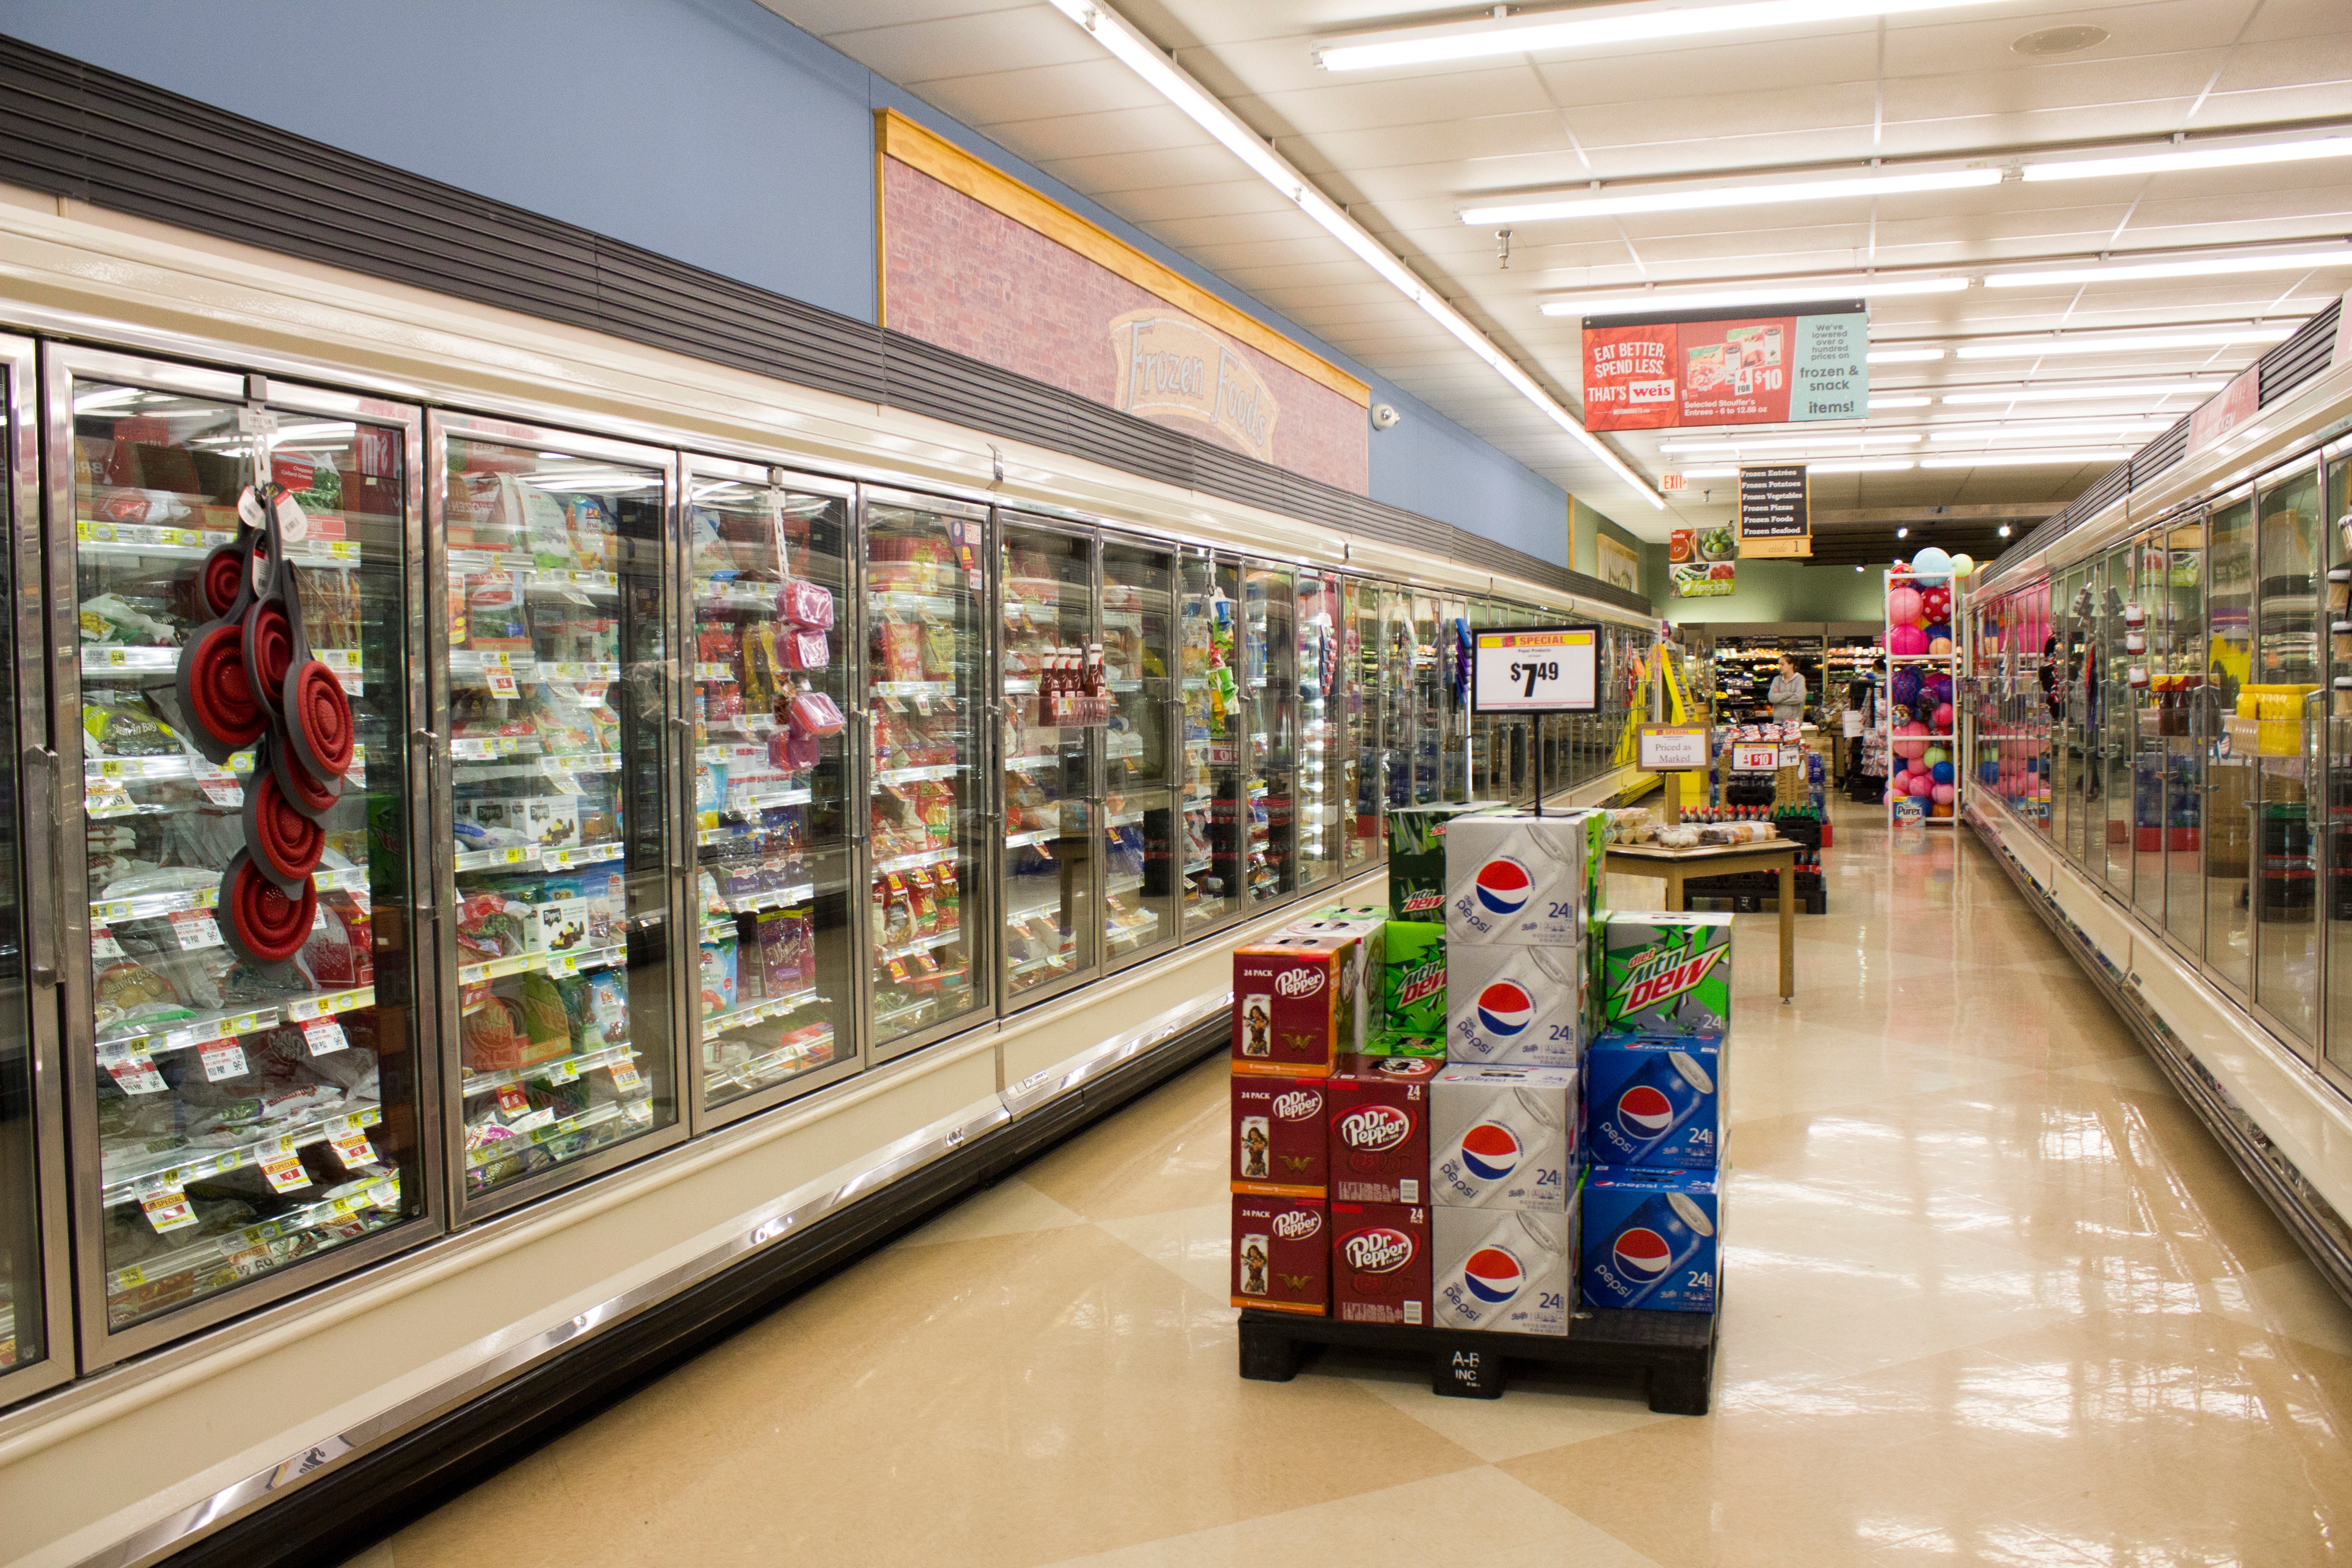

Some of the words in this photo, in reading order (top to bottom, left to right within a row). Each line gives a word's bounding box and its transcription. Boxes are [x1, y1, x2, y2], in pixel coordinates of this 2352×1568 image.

[1594, 344, 1615, 362] EAT
[1618, 342, 1666, 359] BETTER,
[1812, 345, 1848, 353] hundred
[1811, 353, 1836, 362] prices
[1594, 359, 1632, 378] SPEND
[1635, 359, 1665, 375] LESS.
[1800, 367, 1845, 378] frozen
[1849, 365, 1859, 376] &
[1124, 317, 1204, 414] Frozen
[1210, 343, 1266, 446] Foods
[1740, 371, 1747, 383] 4
[1754, 368, 1783, 390] $10
[1738, 385, 1750, 393] FOR
[1809, 380, 1850, 391] snack
[1588, 386, 1627, 402] THAT'S
[1633, 384, 1671, 397] weis
[1684, 400, 1717, 408] Selected
[1719, 398, 1755, 407] Stouffer's
[1809, 401, 1854, 414] items!
[1664, 475, 1682, 489] EXIT
[1766, 492, 1803, 501] Vegetables
[1770, 526, 1801, 534] Seafood
[966, 533, 980, 544] SAVE
[1794, 541, 1799, 552] 1
[1520, 635, 1565, 645] SPECIAL
[142, 721, 157, 732] Bag
[1656, 743, 1681, 751] Priced
[1660, 754, 1690, 762] Marked
[1753, 754, 1769, 766] $10
[1897, 806, 1920, 815] Purex
[1464, 895, 1475, 908] diet
[1455, 900, 1493, 933] pepsi
[1549, 902, 1568, 918] 24
[191, 935, 199, 943] PAY
[1629, 949, 1656, 966] diet
[1292, 968, 1310, 982] Dr
[1627, 951, 1681, 988] Mtn
[1275, 971, 1321, 996] Pepper
[1466, 1016, 1476, 1029] diet
[1703, 1014, 1722, 1029] 24
[1456, 1021, 1494, 1055] pepsi
[1549, 1025, 1569, 1040] 24
[207, 1068, 216, 1077] YOU
[216, 1066, 225, 1074] PAY
[1407, 1084, 1421, 1096] 24
[1290, 1091, 1307, 1105] Dr
[1273, 1094, 1319, 1118] Pepper
[1364, 1111, 1389, 1130] Dr
[1342, 1114, 1404, 1147] Pepper
[1689, 1128, 1709, 1144] 24
[343, 1137, 364, 1147] SPECIAL
[1599, 1122, 1637, 1154] pepsi
[274, 1161, 296, 1171] SPECIAL
[1450, 1159, 1460, 1172] diet
[1440, 1163, 1479, 1199] pepsi
[1537, 1169, 1557, 1186] 24
[157, 1196, 182, 1207] SPECIAL
[332, 1214, 356, 1225] SPECIAL
[1289, 1211, 1307, 1225] Dr
[1411, 1208, 1423, 1220] 24
[1273, 1214, 1318, 1237] Pepper
[1368, 1233, 1392, 1252] Dr
[1345, 1236, 1407, 1268] Pepper
[1594, 1265, 1633, 1298] pepsi
[1688, 1271, 1708, 1287] 24
[1453, 1282, 1463, 1295] diet
[1443, 1287, 1482, 1321] pepsi
[1540, 1293, 1560, 1309] 24
[1455, 1369, 1477, 1381] INC
